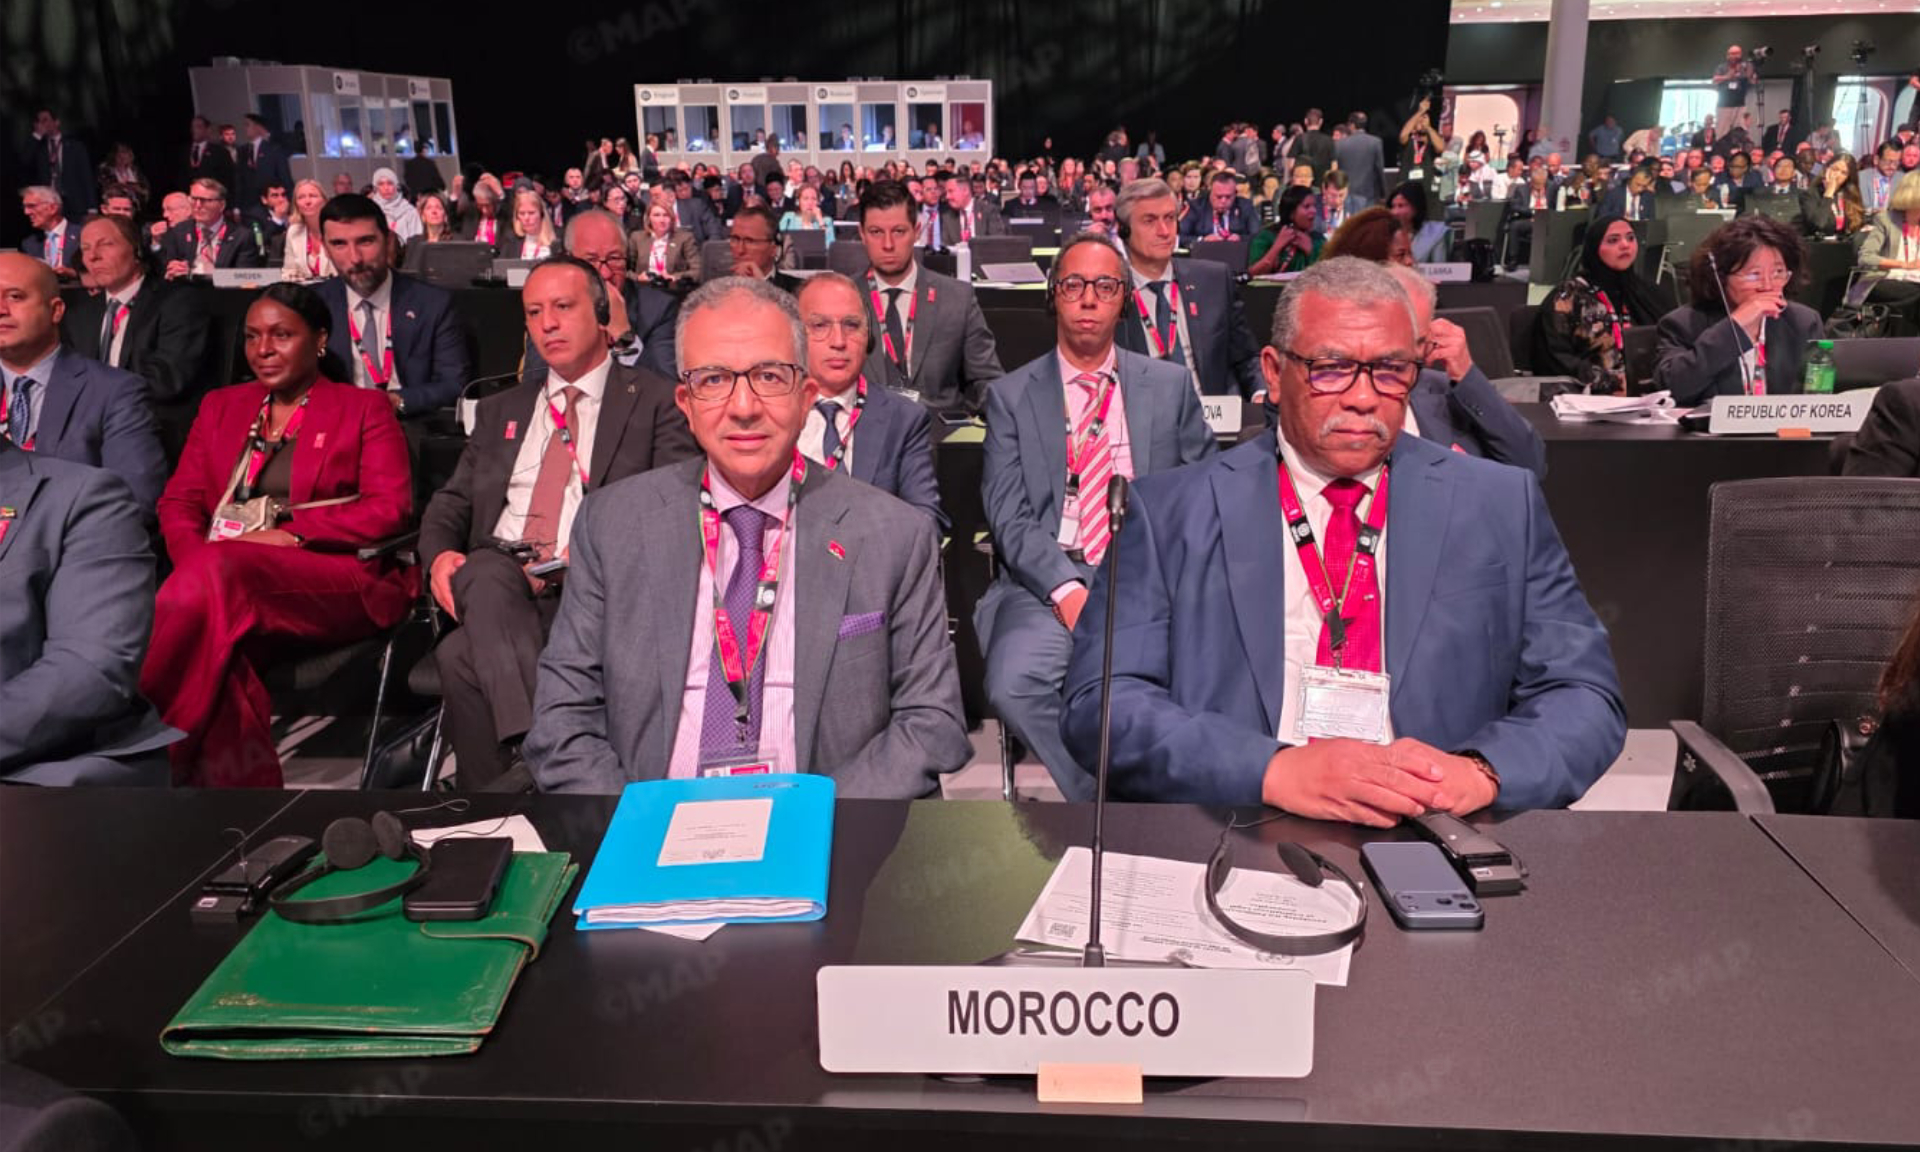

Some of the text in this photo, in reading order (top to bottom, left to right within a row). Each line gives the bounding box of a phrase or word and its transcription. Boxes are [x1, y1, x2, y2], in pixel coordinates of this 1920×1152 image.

[1727, 404, 1852, 419] REPUBLIC OF KOREA
[948, 990, 1180, 1038] MOROCCO
